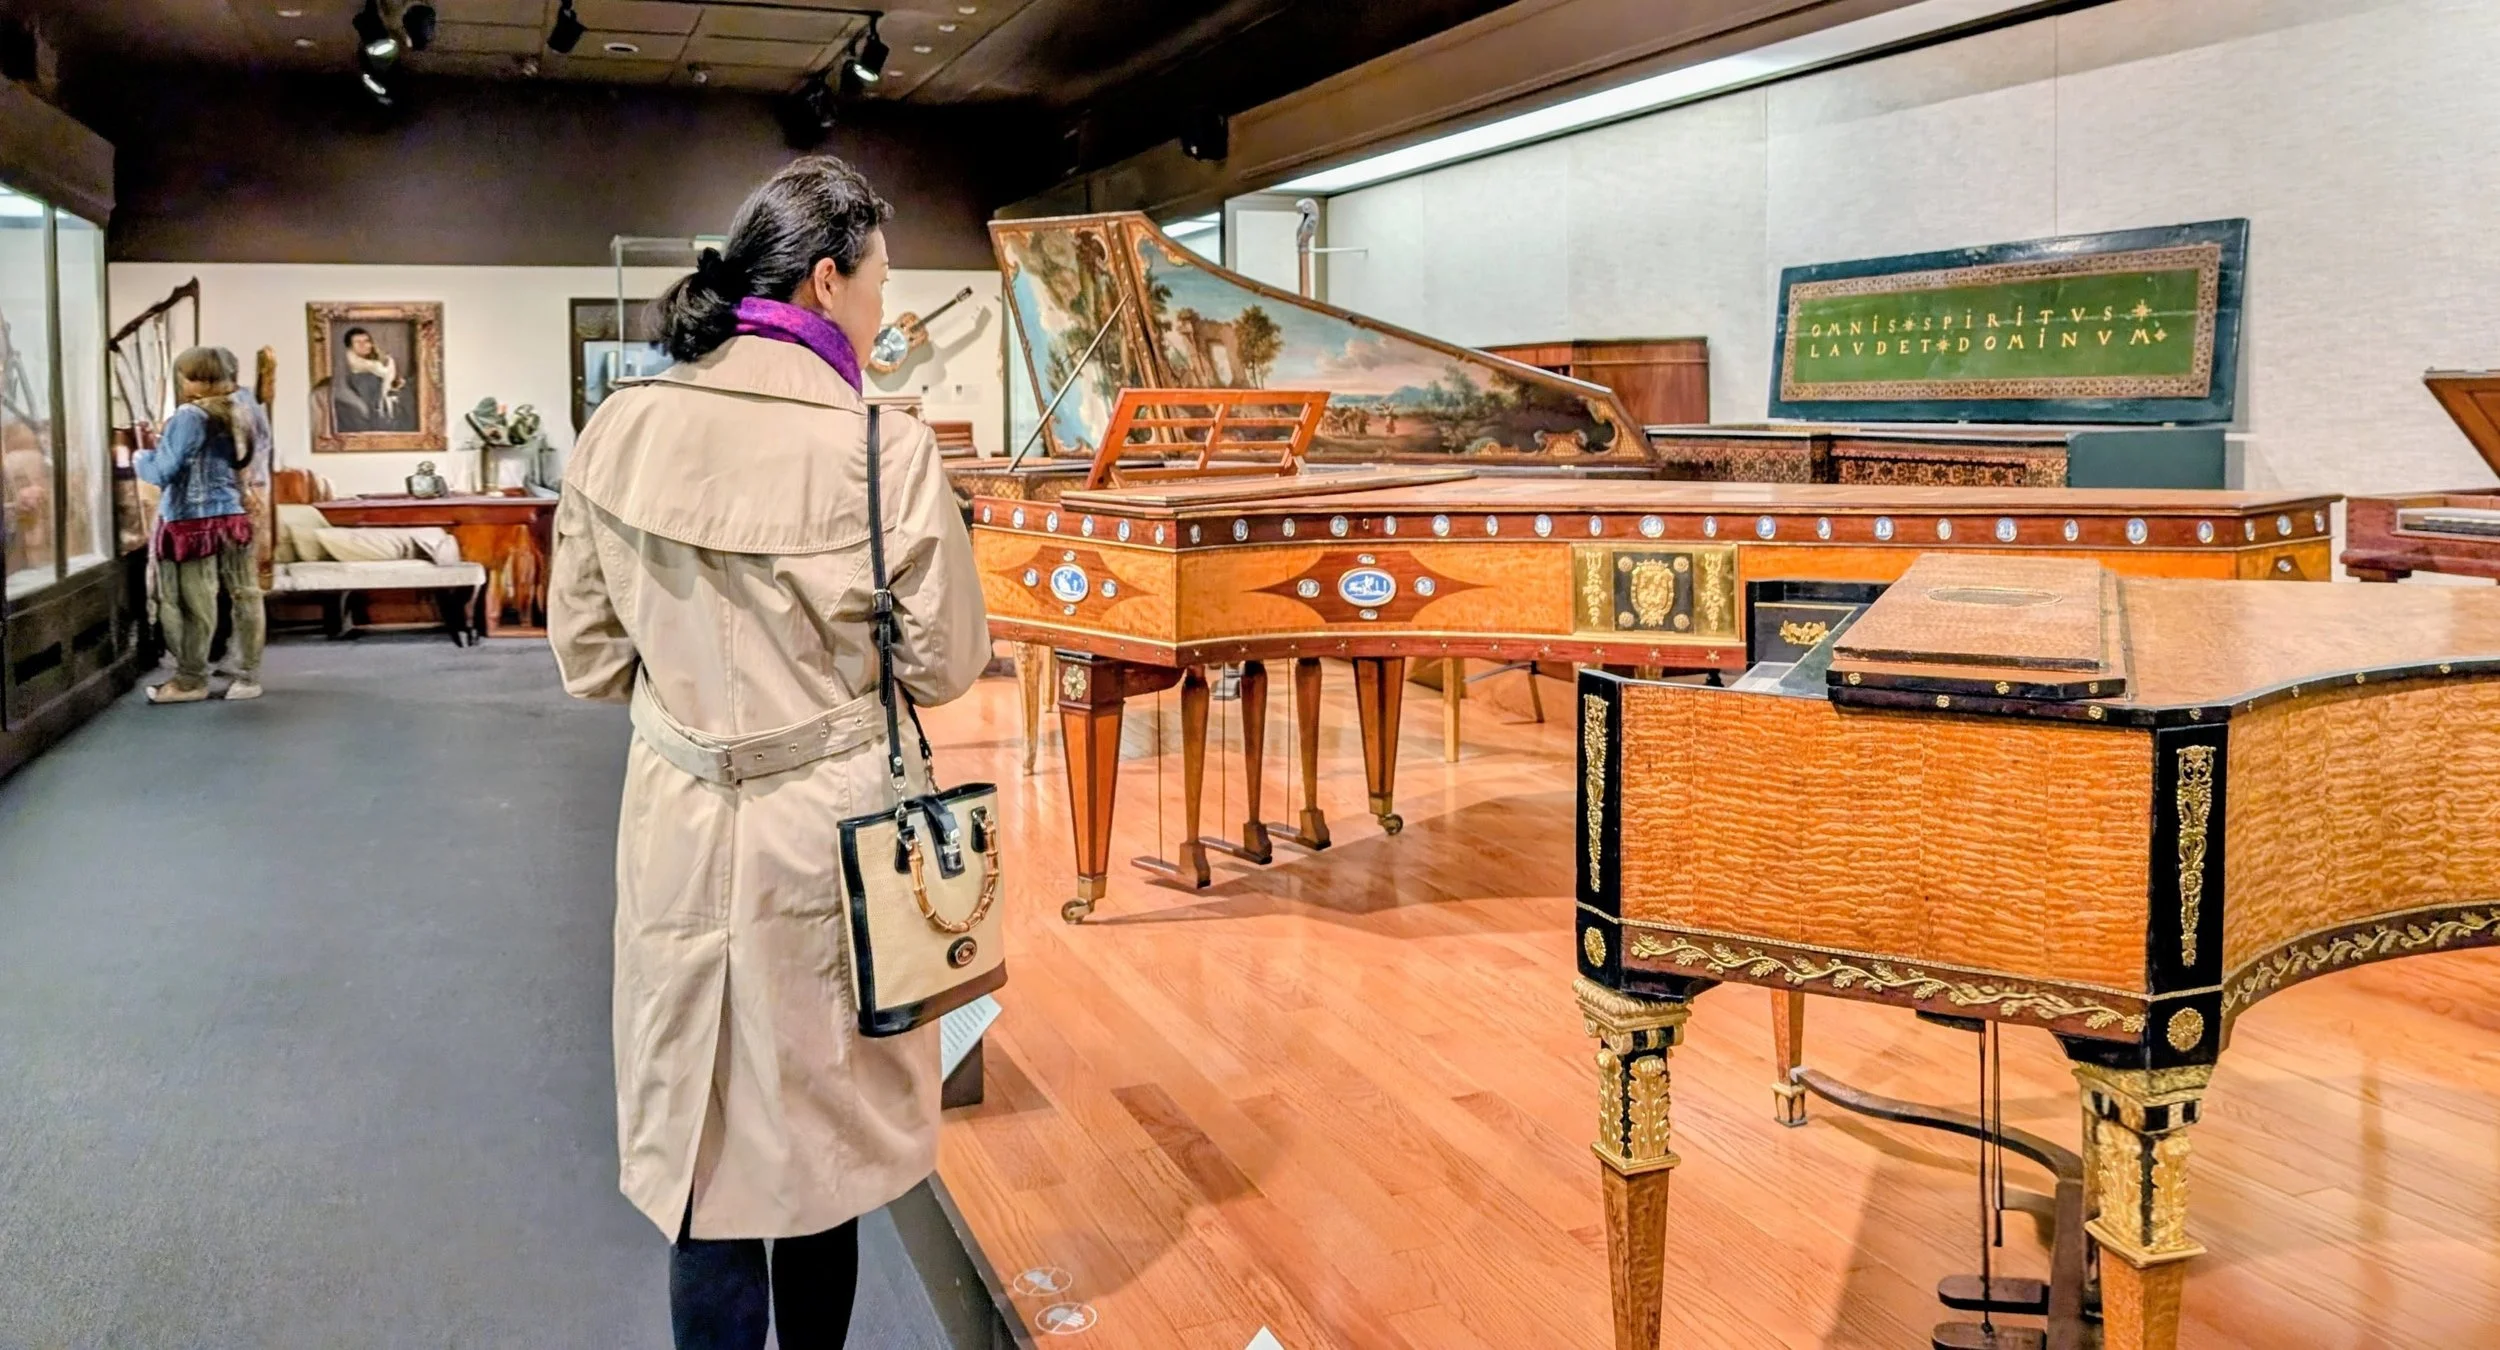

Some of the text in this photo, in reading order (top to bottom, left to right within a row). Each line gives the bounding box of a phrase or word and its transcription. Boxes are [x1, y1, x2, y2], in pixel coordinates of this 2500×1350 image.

[1811, 305, 2113, 338] OMNIS SPIRITVS
[1810, 328, 2152, 358] LAVDET DOMINVM
